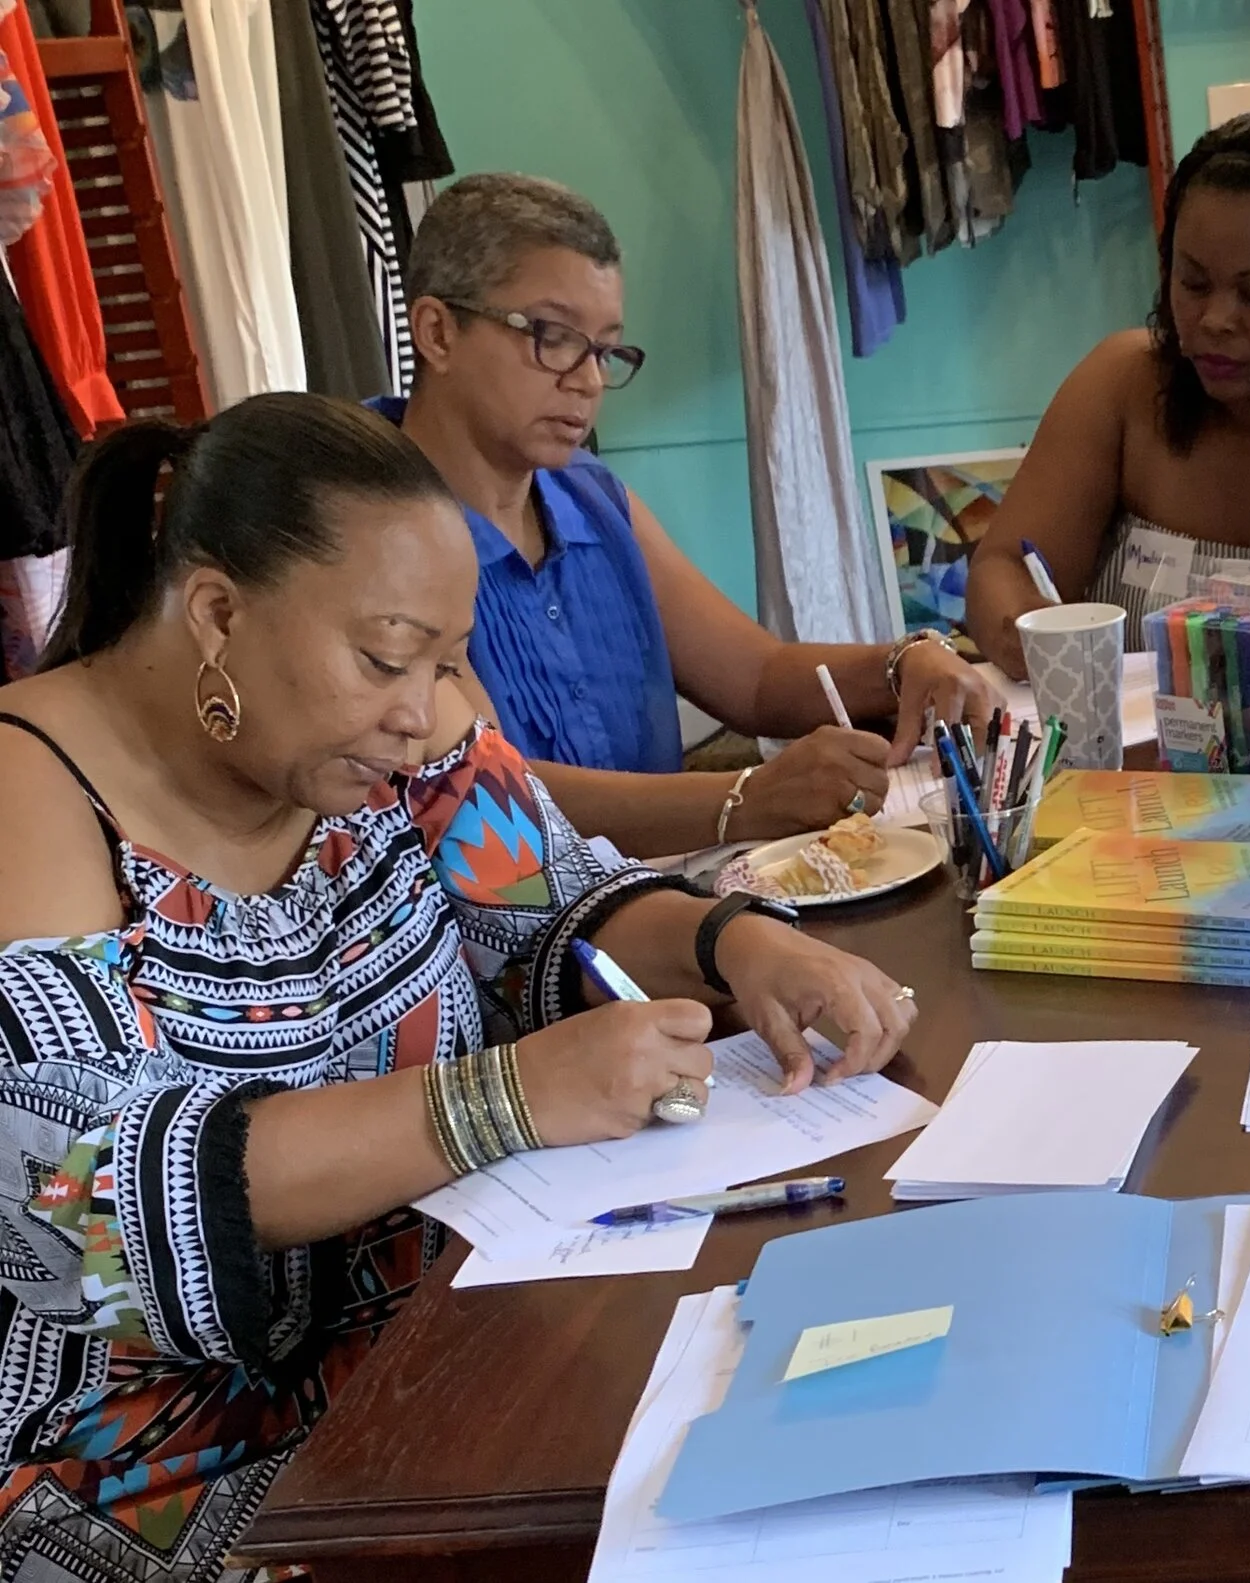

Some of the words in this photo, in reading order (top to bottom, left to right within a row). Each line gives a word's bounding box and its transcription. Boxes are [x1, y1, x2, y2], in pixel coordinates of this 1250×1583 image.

[1163, 716, 1217, 733] permanent
[1165, 727, 1204, 743] markers
[1116, 778, 1174, 833] Launch
[1090, 860, 1141, 898] LIFT
[1135, 847, 1190, 904] Launch
[1037, 906, 1095, 919] LAUNCH
[1034, 923, 1091, 936] LAUNCH
[1032, 944, 1091, 958] LAUNCH
[1033, 963, 1092, 976] LAUNCH
